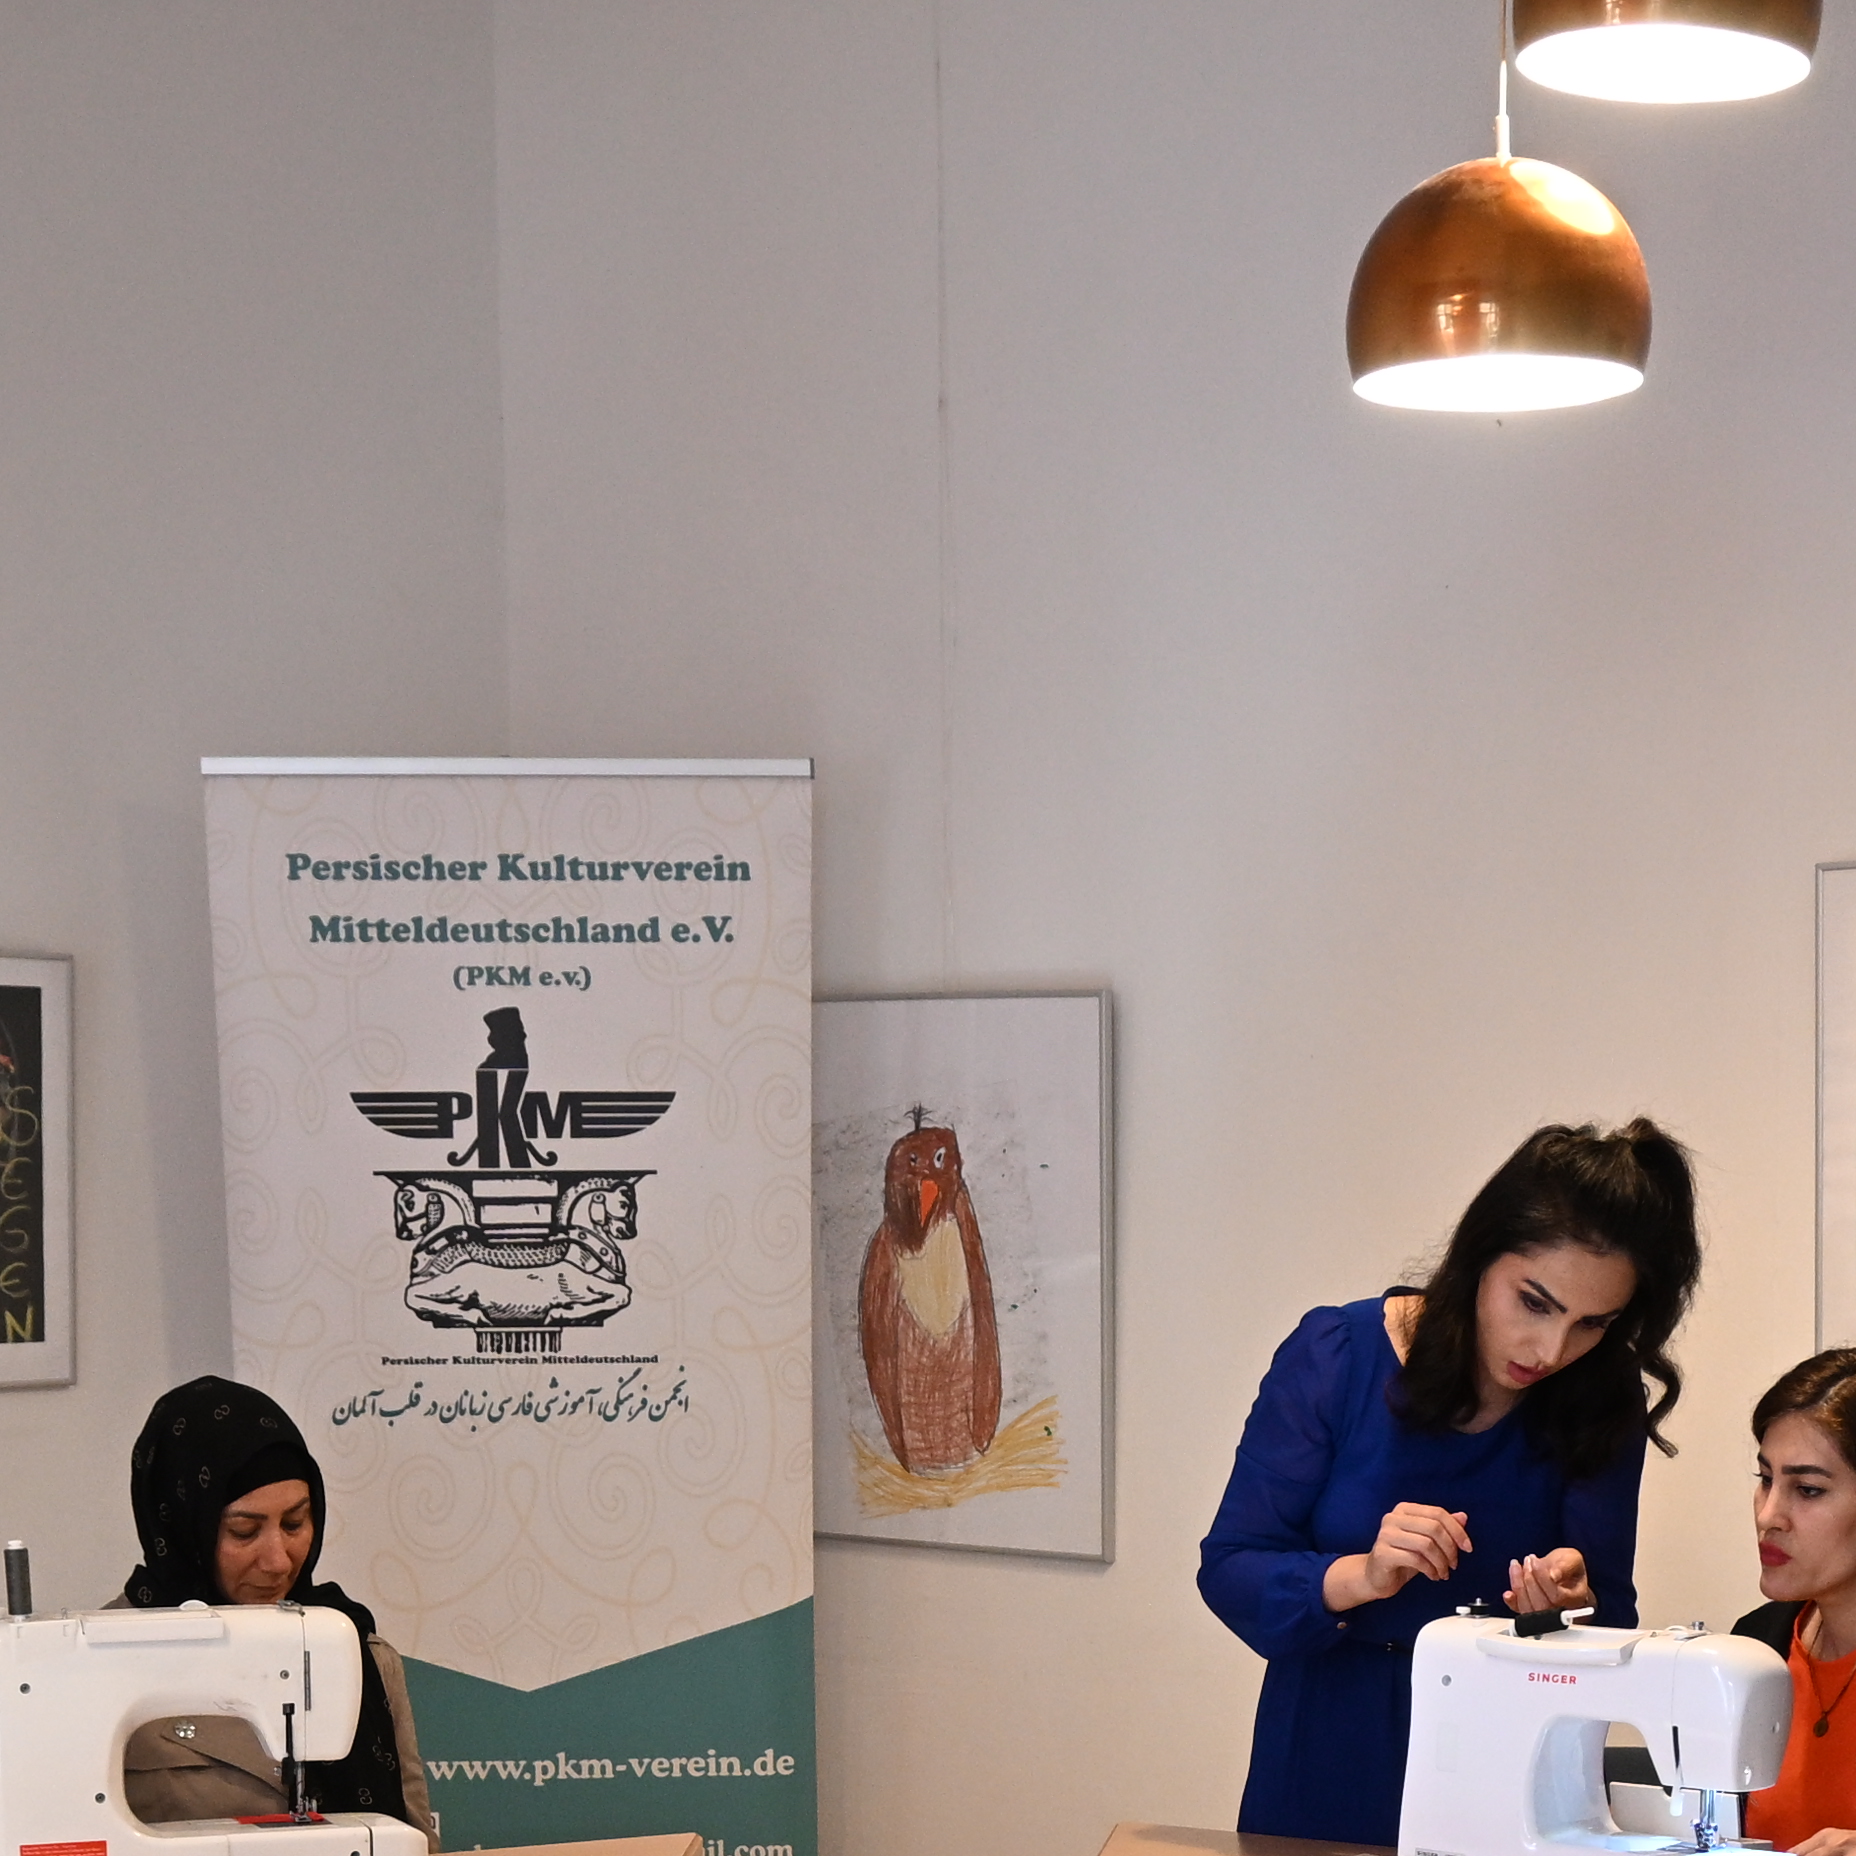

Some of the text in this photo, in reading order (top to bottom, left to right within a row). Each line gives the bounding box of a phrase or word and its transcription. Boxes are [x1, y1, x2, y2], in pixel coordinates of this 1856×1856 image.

[284, 852, 752, 882] Persischer Kulturverein
[308, 914, 735, 944] Mitteldeutschland e.V.
[452, 965, 592, 992] (PKM e.v.)
[381, 1354, 659, 1366] Persischer Kulturverein Mitteldeutschland
[332, 1388, 385, 1426] آلمان
[379, 1381, 424, 1427] قلب
[424, 1400, 438, 1417] در
[648, 1365, 690, 1422] انجمن
[1527, 1672, 1577, 1685] SINGER
[426, 1748, 796, 1787] www.pkm-verein.de
